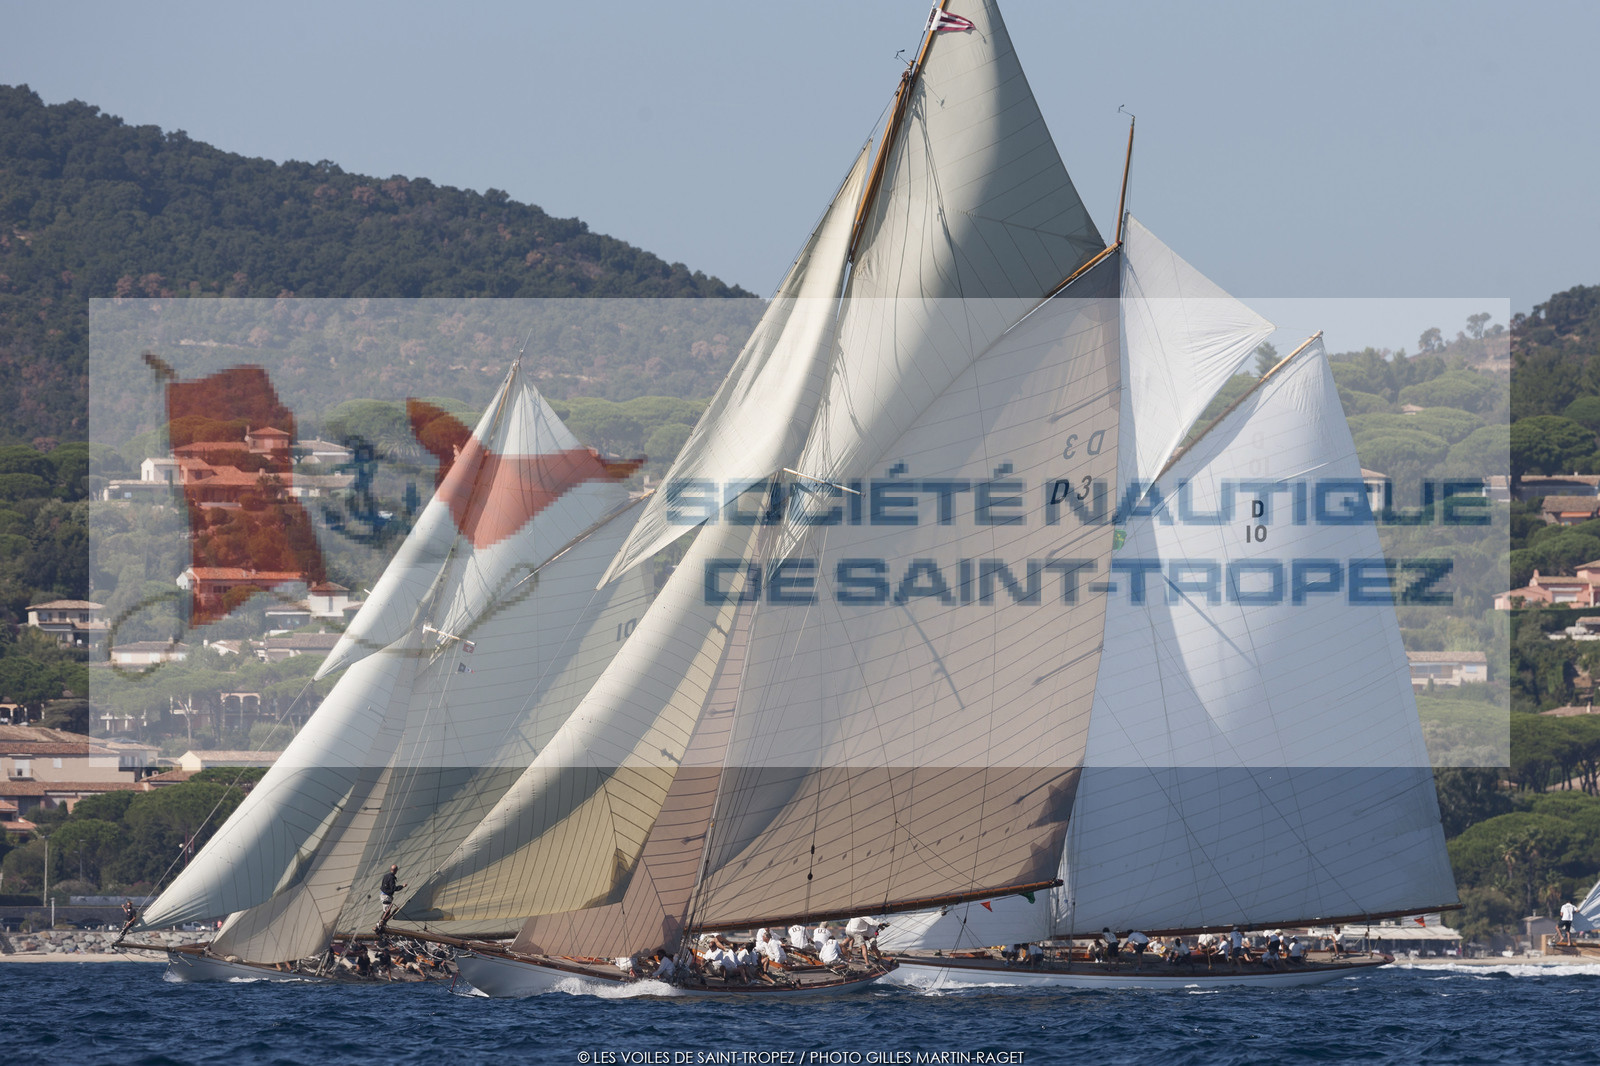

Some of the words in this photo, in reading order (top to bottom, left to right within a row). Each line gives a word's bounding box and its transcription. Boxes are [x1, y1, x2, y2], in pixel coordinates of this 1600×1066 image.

[1050, 479, 1070, 505] D
[1077, 475, 1093, 500] 3
[1251, 500, 1264, 518] D
[1246, 525, 1268, 543] 10
